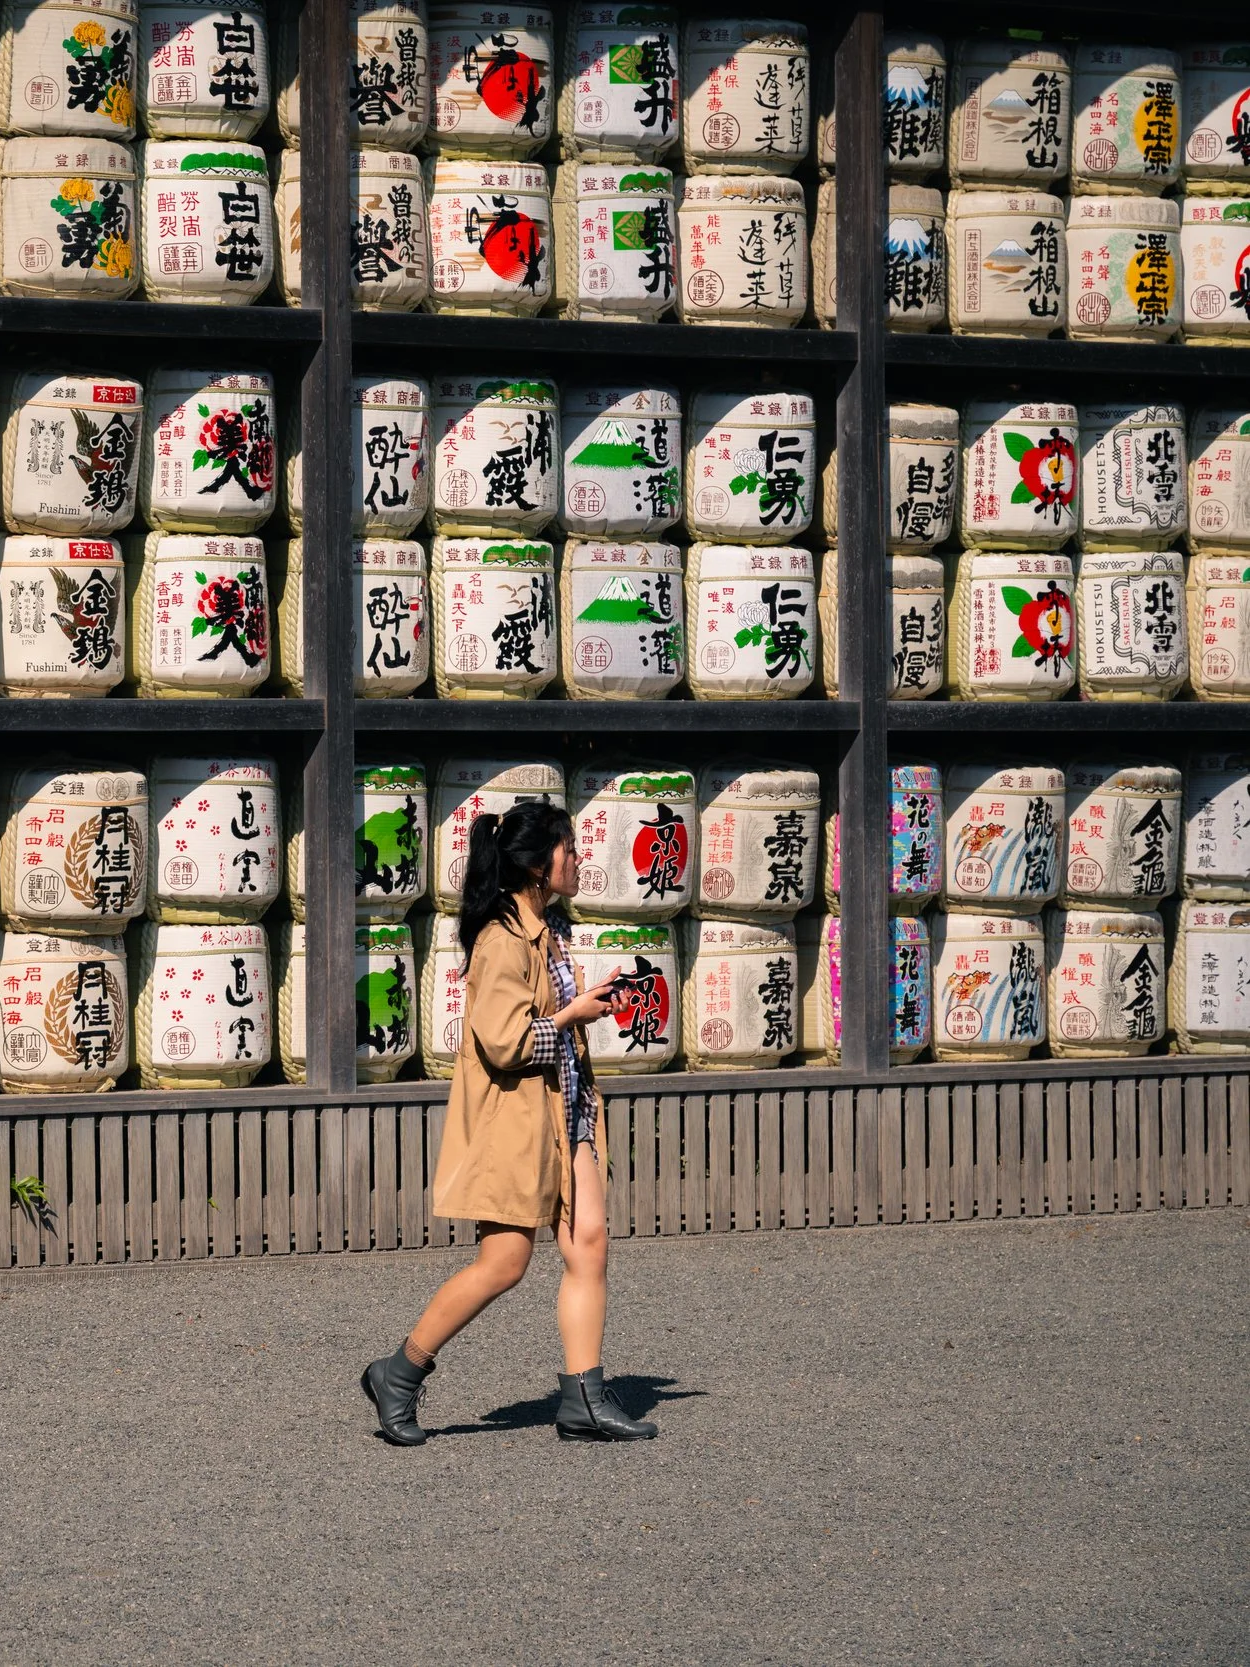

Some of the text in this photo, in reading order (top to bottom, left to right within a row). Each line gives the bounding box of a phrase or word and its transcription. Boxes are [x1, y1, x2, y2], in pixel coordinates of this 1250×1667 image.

[581, 10, 614, 24] 登録
[699, 28, 730, 42] 登録
[1023, 72, 1062, 170] 箱根山
[152, 159, 179, 169] 登録
[582, 177, 617, 191] 登録
[681, 186, 711, 200] 登録
[1024, 221, 1061, 317] 箱根山
[96, 387, 134, 402] 京仕込
[158, 414, 173, 456] 香四海
[174, 404, 186, 440] 芳醇
[704, 437, 717, 478] 唯一家
[1124, 438, 1132, 470] ISLAND
[1146, 429, 1178, 502] 北雪
[160, 462, 170, 496] 南部美人
[174, 462, 182, 496] 株式会社
[759, 430, 806, 526] 仁勇
[1098, 433, 1106, 513] HOKUSETSU
[38, 503, 80, 516] Fushimi
[72, 544, 112, 558] 京仕込
[446, 548, 480, 562] 登録
[591, 550, 627, 562] 登録
[171, 572, 184, 606] 芳醇
[1208, 568, 1241, 580] 登録
[156, 582, 170, 624] 香四海
[707, 592, 719, 632] 唯一家
[1145, 580, 1177, 653] 北雪
[160, 630, 168, 664] 南部美人
[174, 628, 182, 664] 株式会社
[761, 582, 808, 679] 仁勇
[973, 588, 986, 678] 雪椿酒造株式会社
[26, 662, 67, 672] Fushimi
[50, 780, 84, 796] 登録
[711, 779, 742, 793] 登録
[1000, 775, 1032, 788] 登録
[637, 803, 685, 900] 京姫
[902, 794, 930, 883] 花の舞
[93, 806, 131, 915] 月桂冠
[764, 810, 808, 903] 嘉泉
[982, 921, 1012, 934] 登録
[1060, 922, 1090, 934] 登録
[1194, 912, 1226, 925] 登録
[26, 938, 60, 952] 登録
[703, 930, 734, 943] 登録
[619, 956, 669, 1053] 京姫
[758, 956, 801, 1049] 嘉泉
[896, 947, 920, 1036] 花の舞
[72, 961, 112, 1070] 月桂冠
